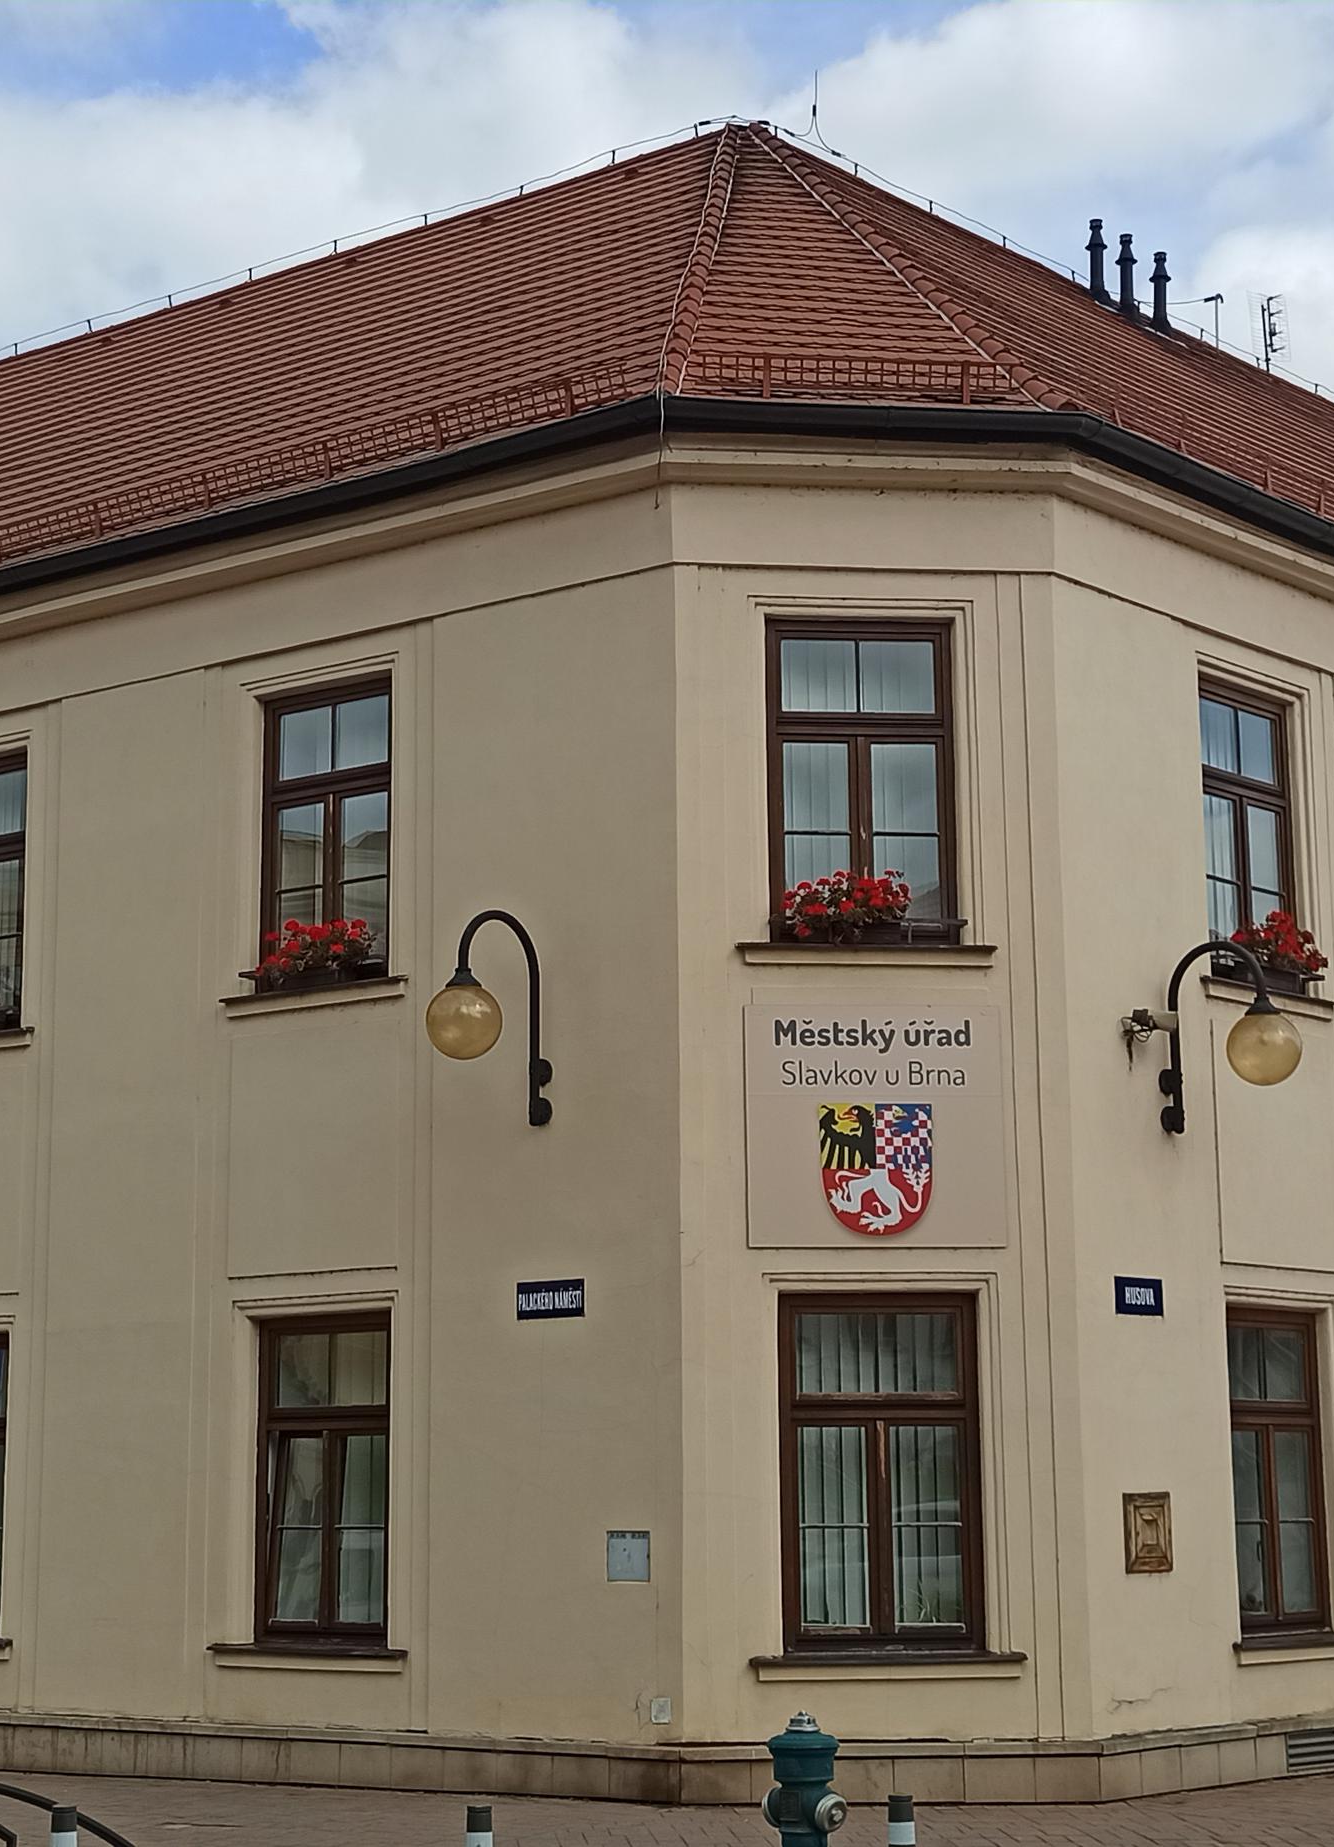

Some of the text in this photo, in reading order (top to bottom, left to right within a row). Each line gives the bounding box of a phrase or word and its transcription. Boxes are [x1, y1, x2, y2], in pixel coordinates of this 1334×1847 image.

[773, 1019, 971, 1054] Městský úřad
[781, 1060, 967, 1086] Slavkov u Brna
[518, 1285, 582, 1312] PALACKÉHO NÁMĚSTÍ
[1124, 1286, 1155, 1306] HUSOVA
